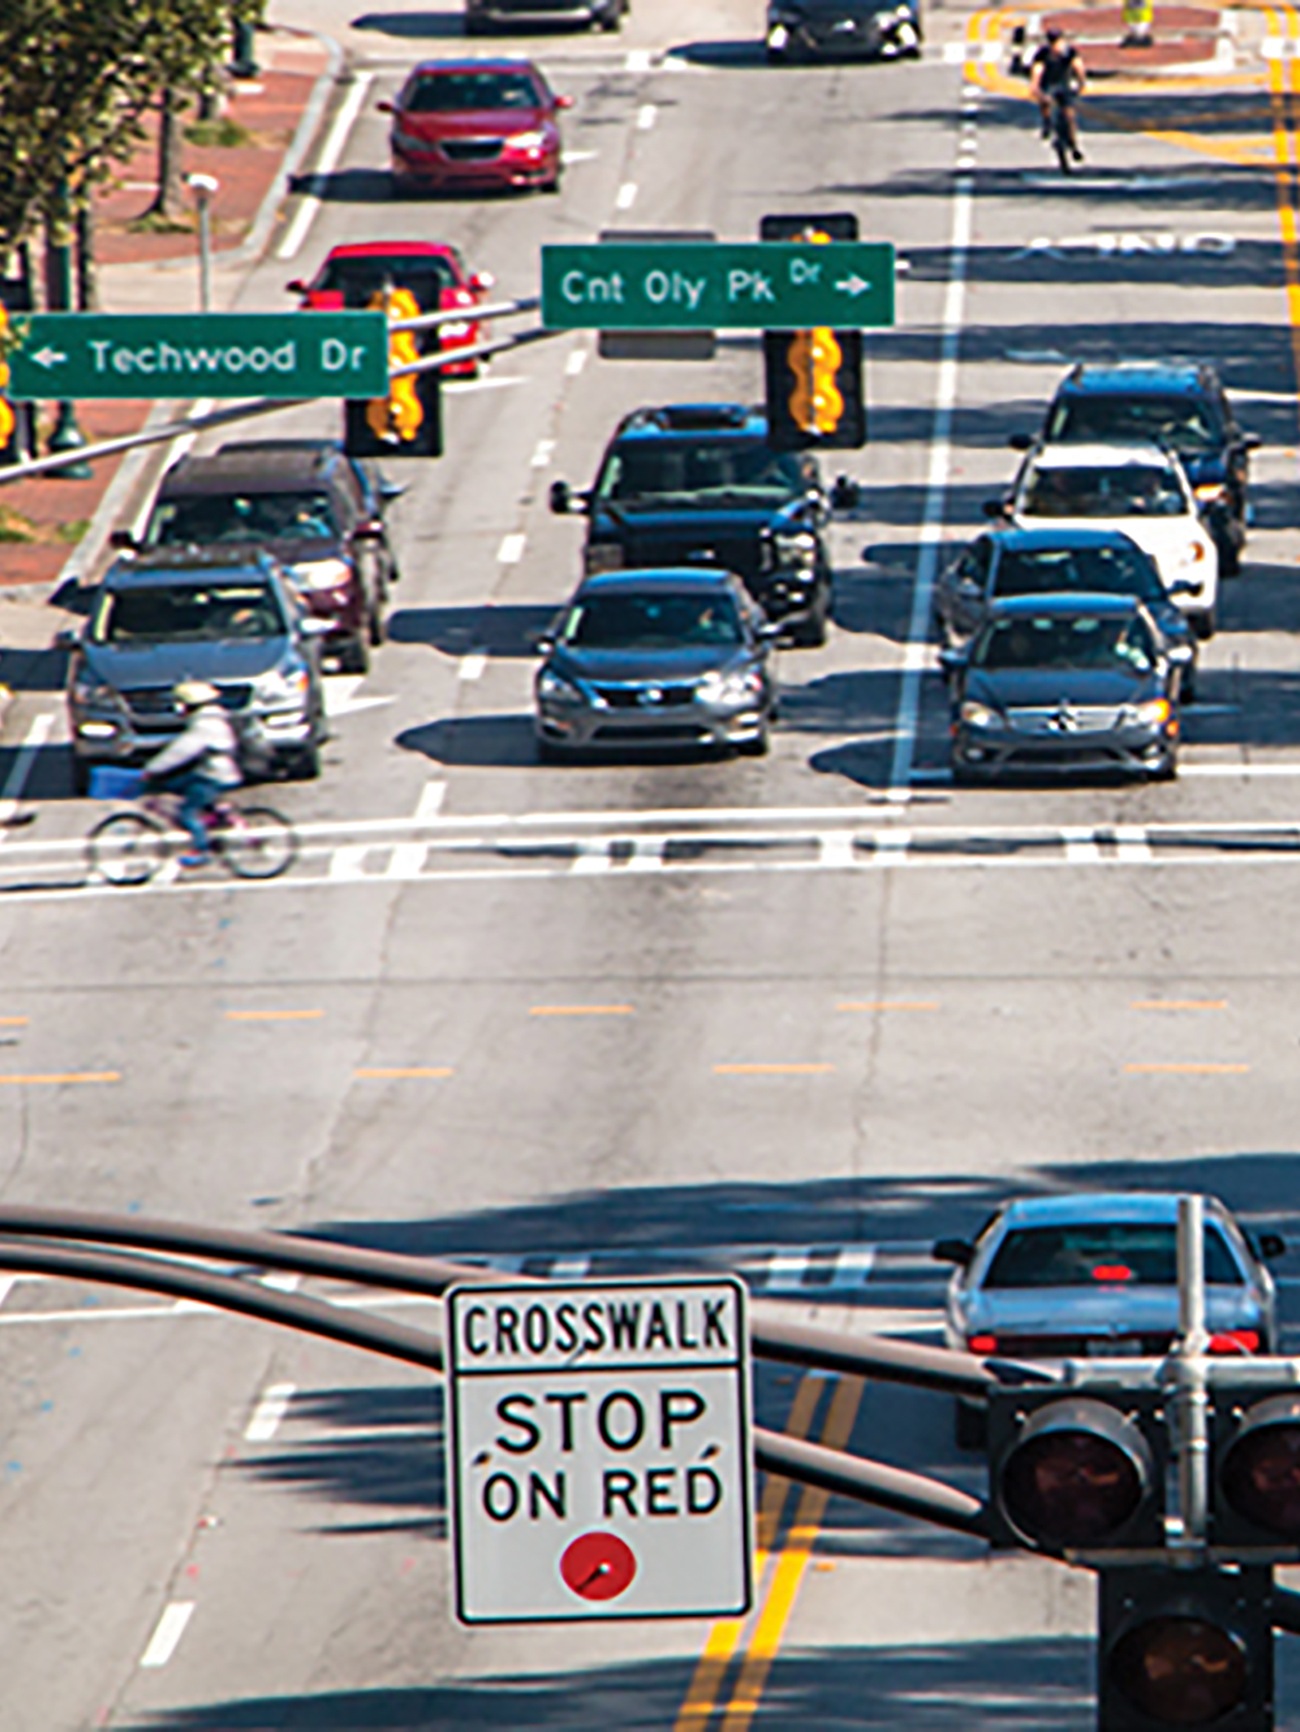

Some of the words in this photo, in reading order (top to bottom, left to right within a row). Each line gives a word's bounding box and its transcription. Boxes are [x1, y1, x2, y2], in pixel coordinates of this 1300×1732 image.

[561, 270, 626, 304] Cnt
[645, 270, 706, 309] Oly
[728, 269, 776, 303] Pk
[789, 258, 821, 285] Dr
[88, 340, 296, 373] Techwood
[321, 339, 366, 371] Dr
[464, 1300, 728, 1356] CROSSWALK
[496, 1390, 707, 1455] STOP
[483, 1469, 567, 1521] ON
[603, 1466, 722, 1518] RED
